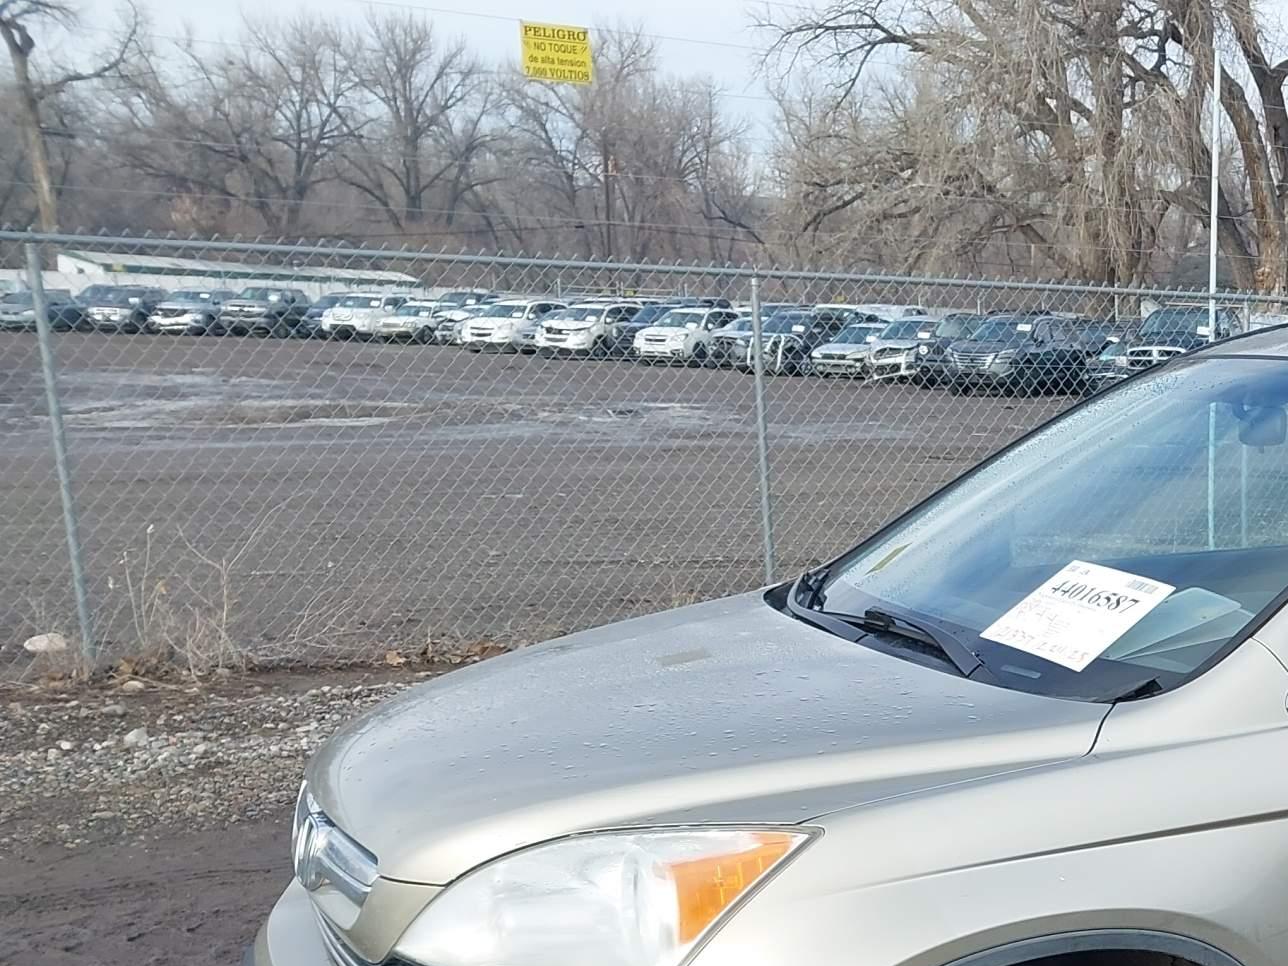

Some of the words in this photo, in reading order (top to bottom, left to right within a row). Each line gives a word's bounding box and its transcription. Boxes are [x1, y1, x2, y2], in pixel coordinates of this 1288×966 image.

[523, 25, 587, 41] PELIGRO
[534, 41, 546, 52] NO
[548, 42, 578, 54] TOQUE
[528, 54, 539, 63] de
[549, 67, 590, 80] VOLTIOS
[1051, 580, 1140, 613] 44016587
